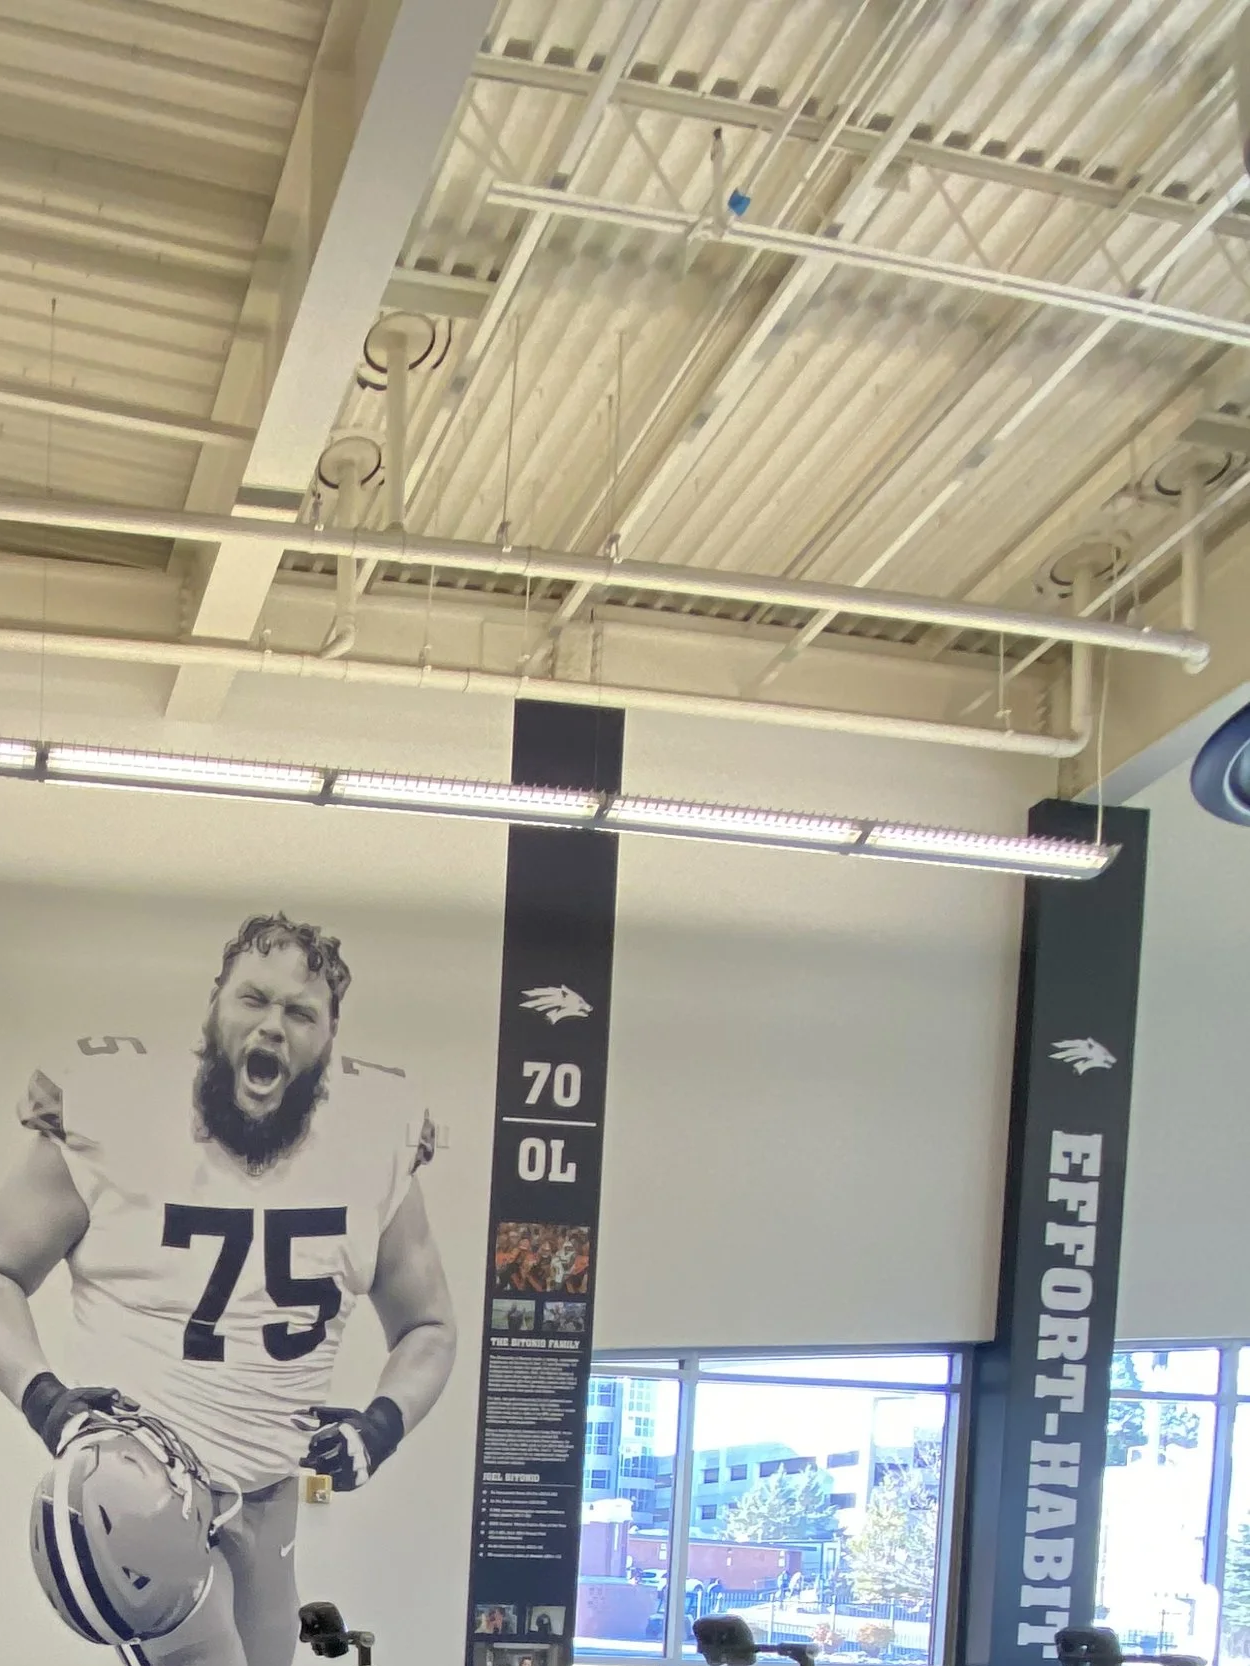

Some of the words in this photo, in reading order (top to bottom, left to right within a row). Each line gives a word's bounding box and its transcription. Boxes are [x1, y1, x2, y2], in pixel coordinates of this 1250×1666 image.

[522, 1061, 582, 1108] 70
[517, 1137, 577, 1183] OL
[161, 1202, 348, 1362] 75
[490, 1337, 509, 1347] THE
